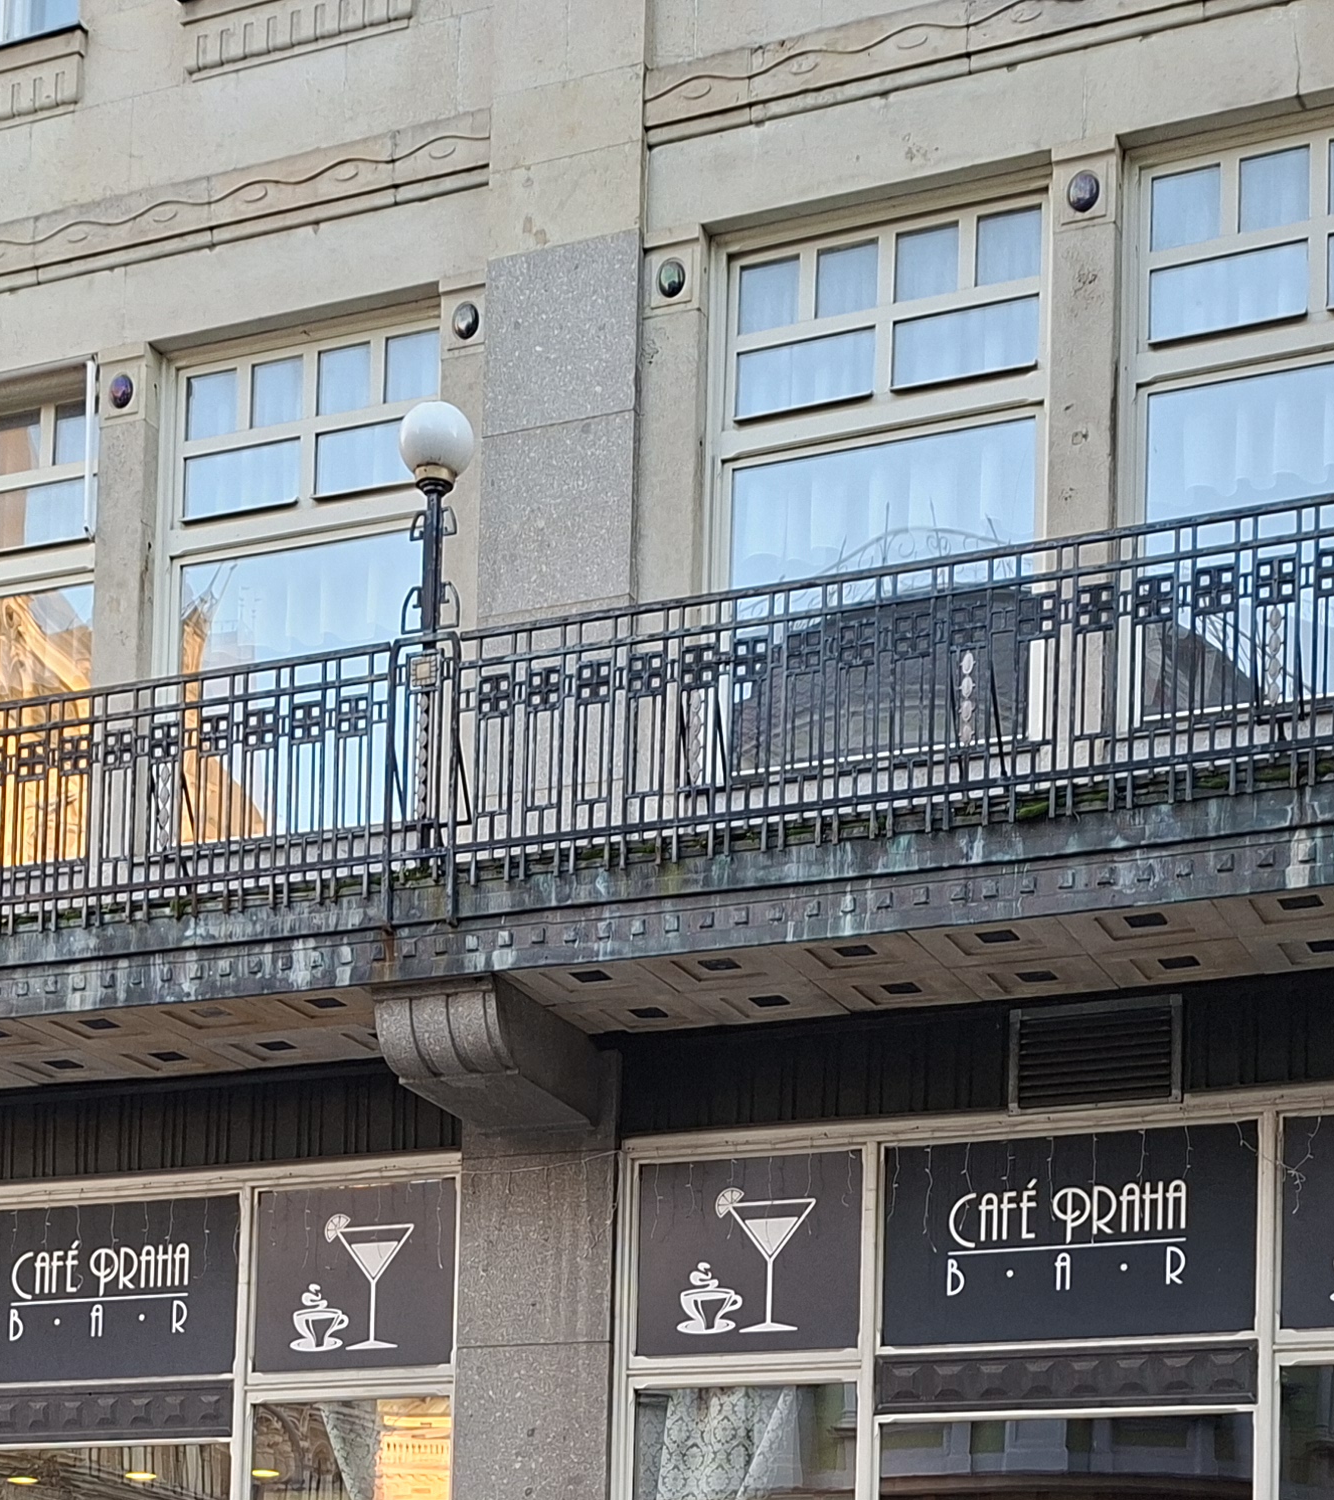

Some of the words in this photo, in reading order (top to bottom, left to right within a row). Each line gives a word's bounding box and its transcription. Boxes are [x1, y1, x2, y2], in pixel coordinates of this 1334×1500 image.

[948, 1178, 1038, 1249] CAFÉ
[1052, 1179, 1187, 1245] PRAHA
[11, 1239, 81, 1300] CAFÉ
[89, 1242, 190, 1297] PRAHA
